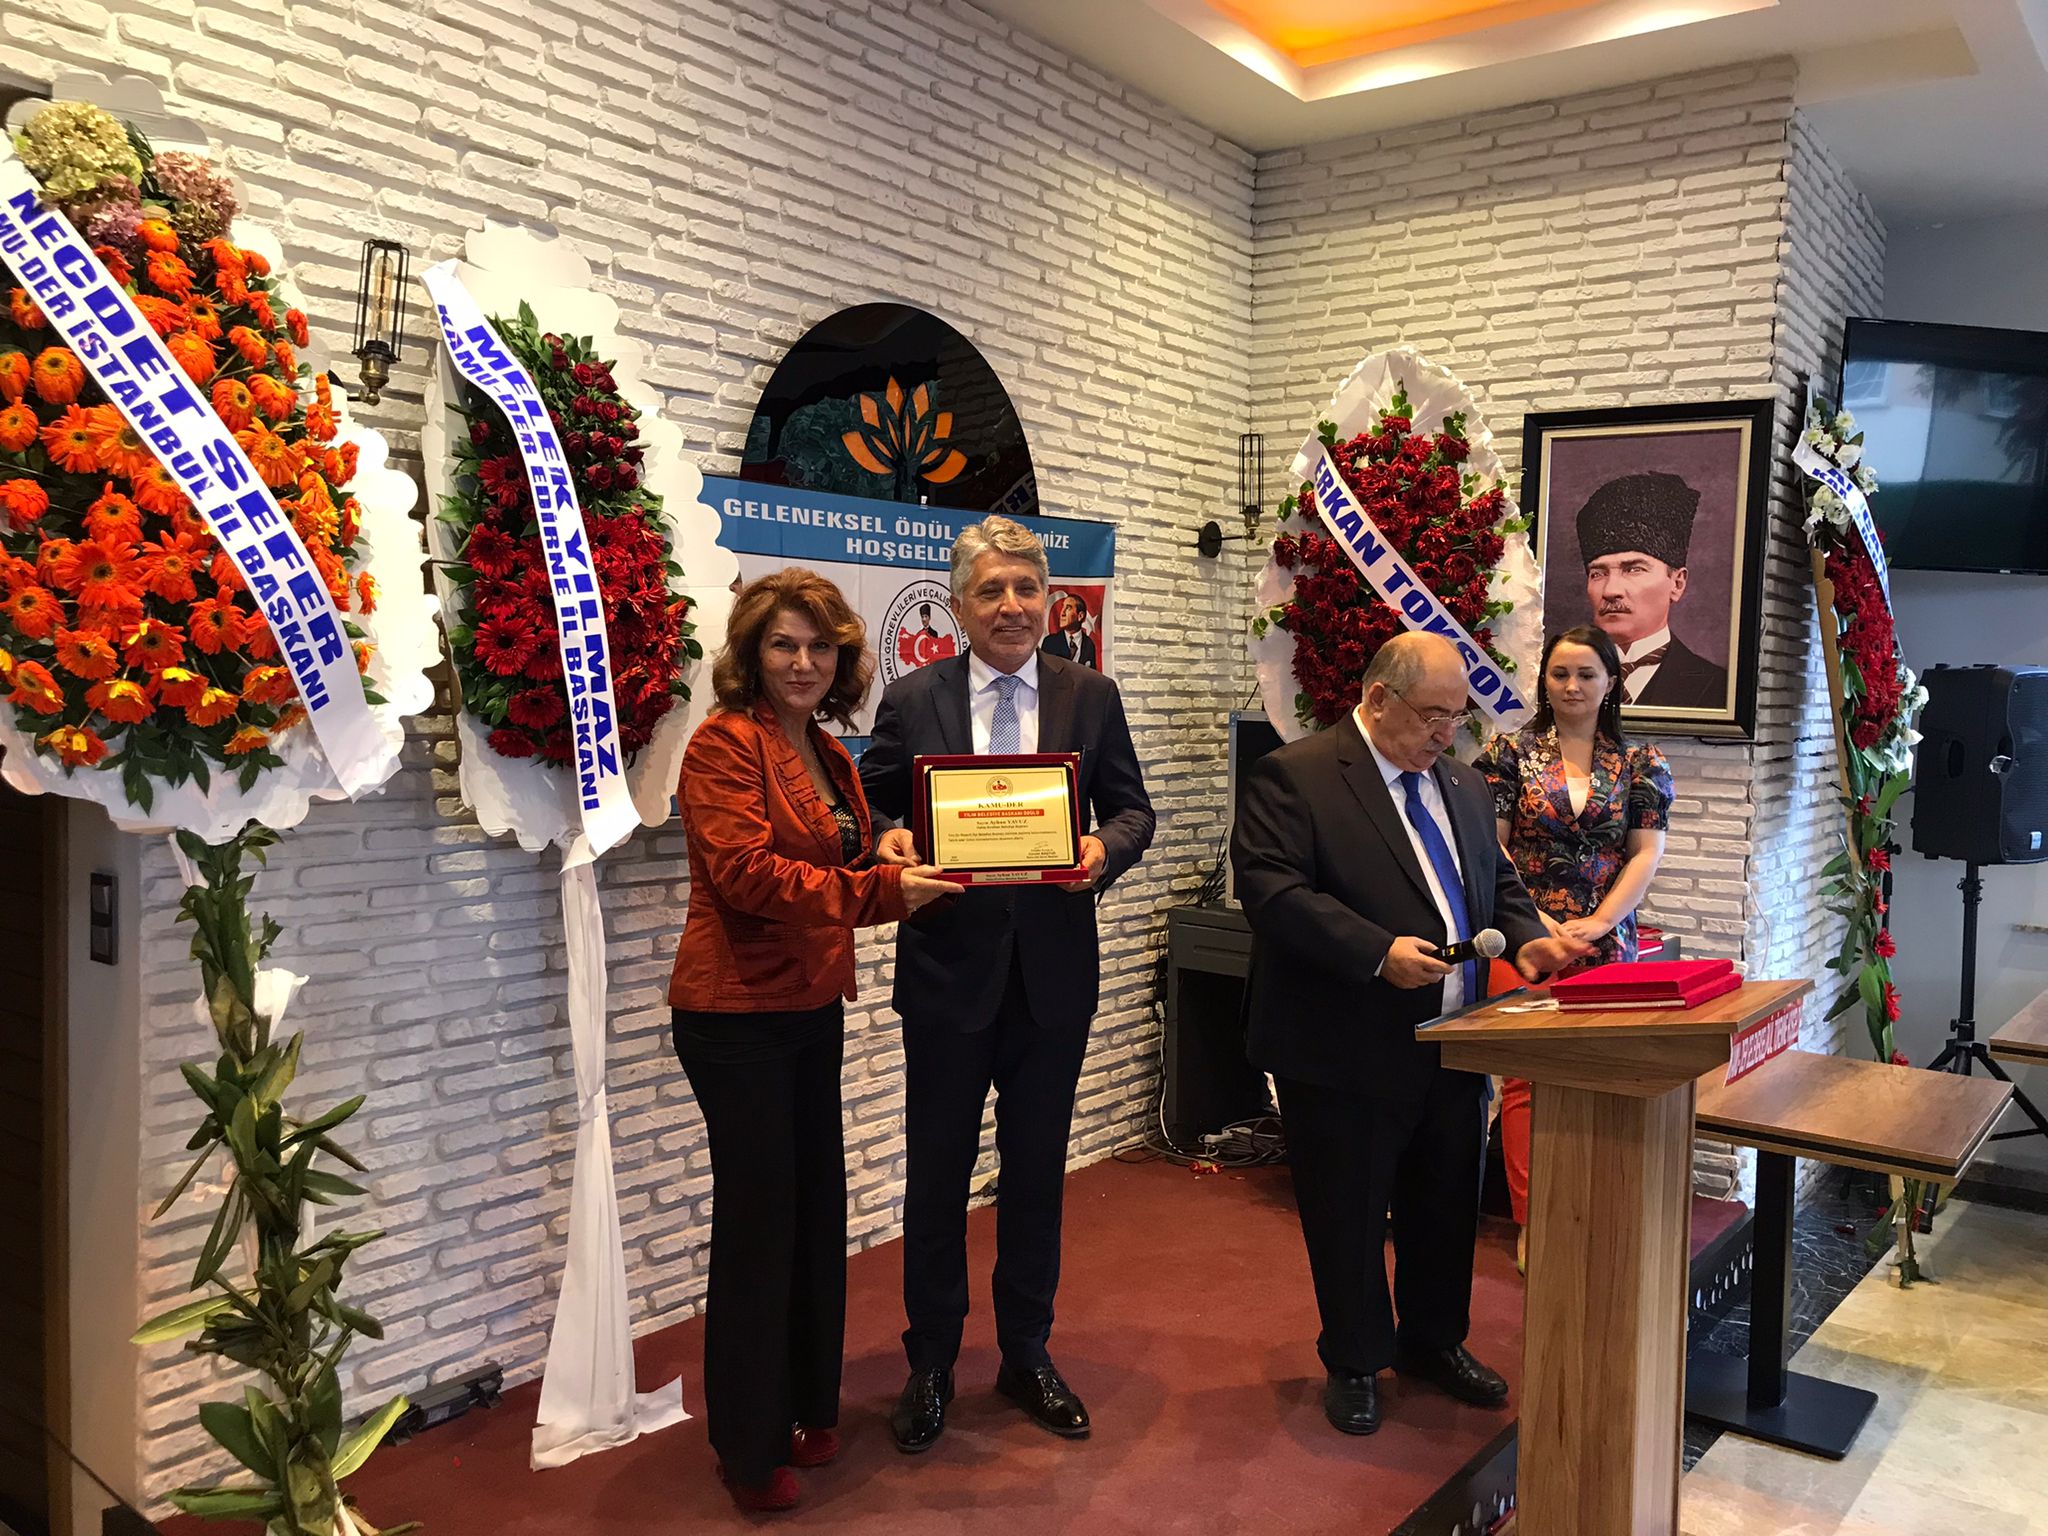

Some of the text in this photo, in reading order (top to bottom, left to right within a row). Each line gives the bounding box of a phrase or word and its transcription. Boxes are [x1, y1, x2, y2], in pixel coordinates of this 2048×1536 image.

[8, 188, 344, 666] NECDET SEFER
[67, 319, 214, 501] İSTANBUL
[208, 503, 242, 542] İL
[236, 544, 331, 712] BAŞKANI
[465, 325, 619, 778] MELEK YILMAZ
[723, 498, 887, 534] GELENEKSEL
[895, 517, 955, 541] ÖDÜL
[437, 304, 600, 811] KAMU-DER EDİRNE İL BAŞKANI
[884, 590, 917, 654] GÖREVLİLERİ
[885, 657, 896, 682] AMU
[917, 588, 928, 598] VE
[1315, 455, 1525, 715] ERKAN TOKSOY
